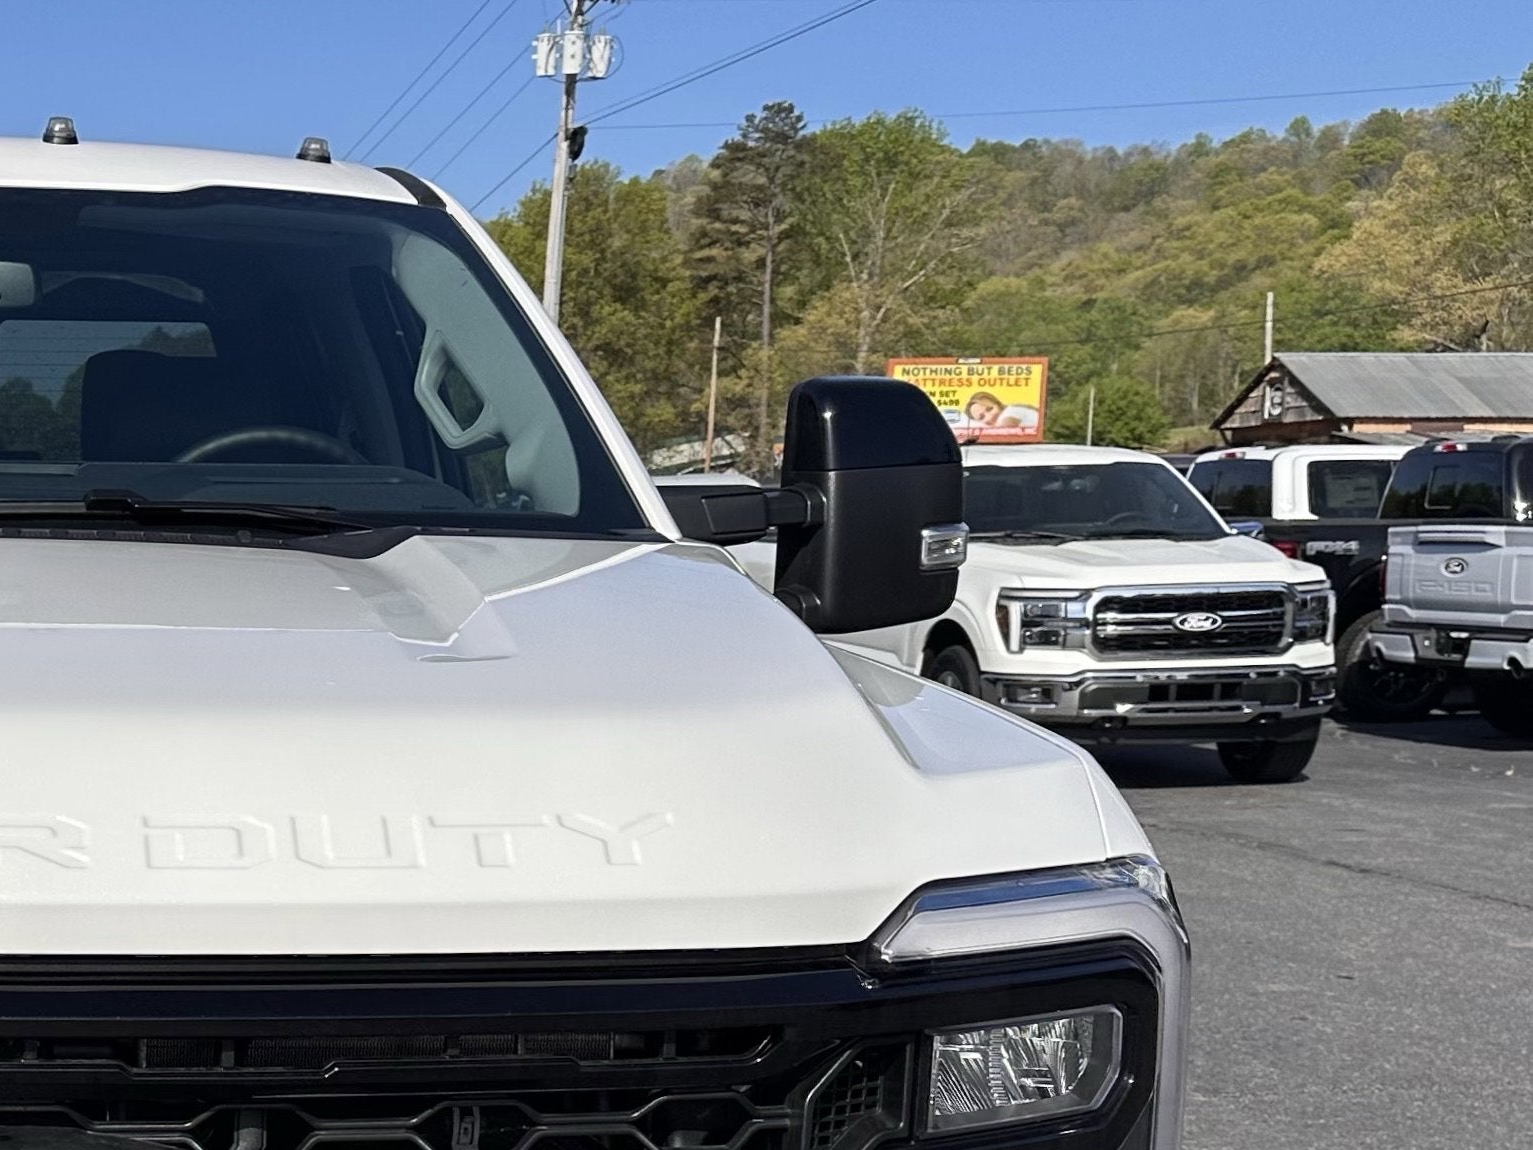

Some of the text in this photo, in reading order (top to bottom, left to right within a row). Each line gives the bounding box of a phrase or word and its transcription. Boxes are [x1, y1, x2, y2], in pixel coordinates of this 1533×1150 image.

[901, 366, 1032, 377] NOTHING BUT BEDS
[909, 377, 1032, 388] ATTRESS OUTLET
[141, 812, 675, 869] DUTY
